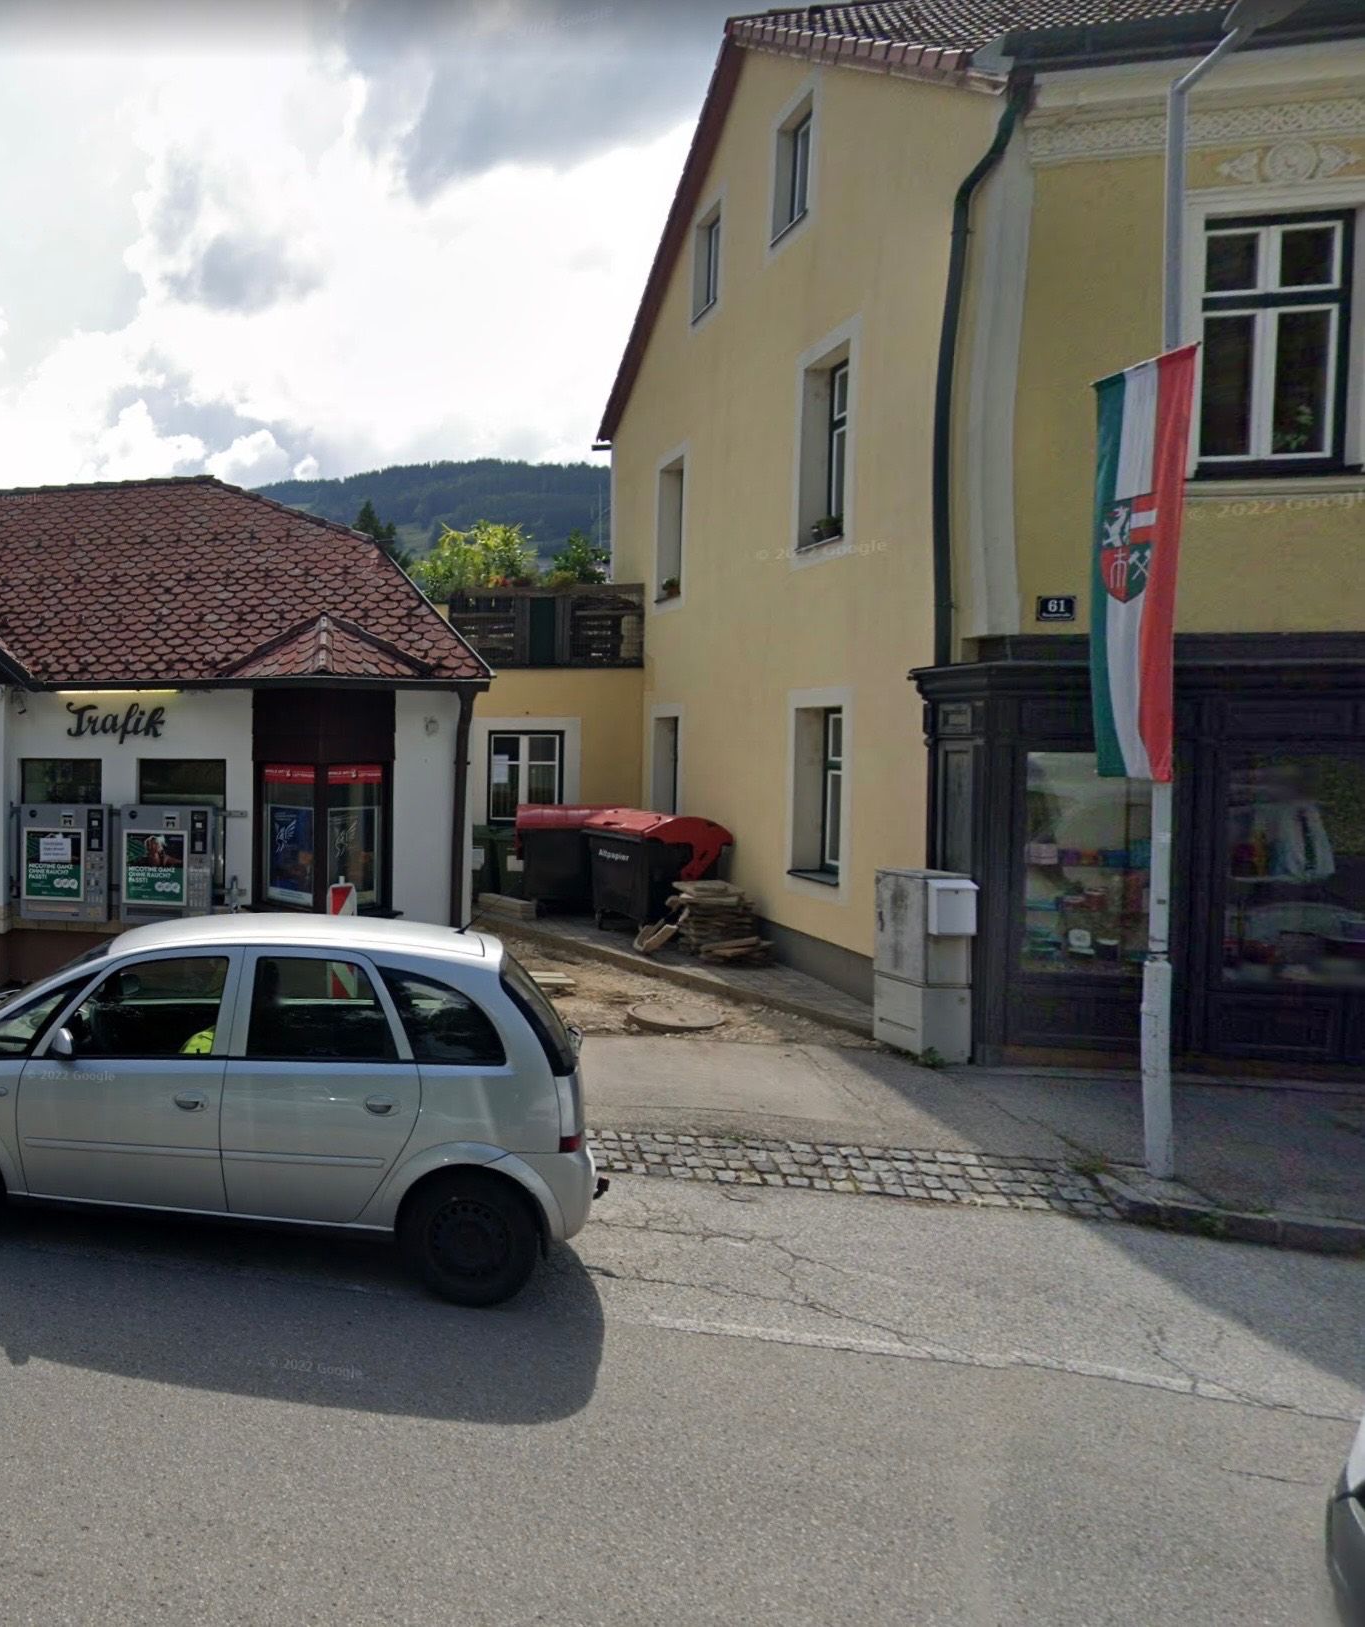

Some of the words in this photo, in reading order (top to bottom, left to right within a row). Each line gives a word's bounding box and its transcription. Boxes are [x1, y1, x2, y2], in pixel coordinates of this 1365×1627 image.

[1047, 599, 1066, 613] 61
[66, 702, 165, 744] Trafik
[598, 848, 630, 861] Altpapier
